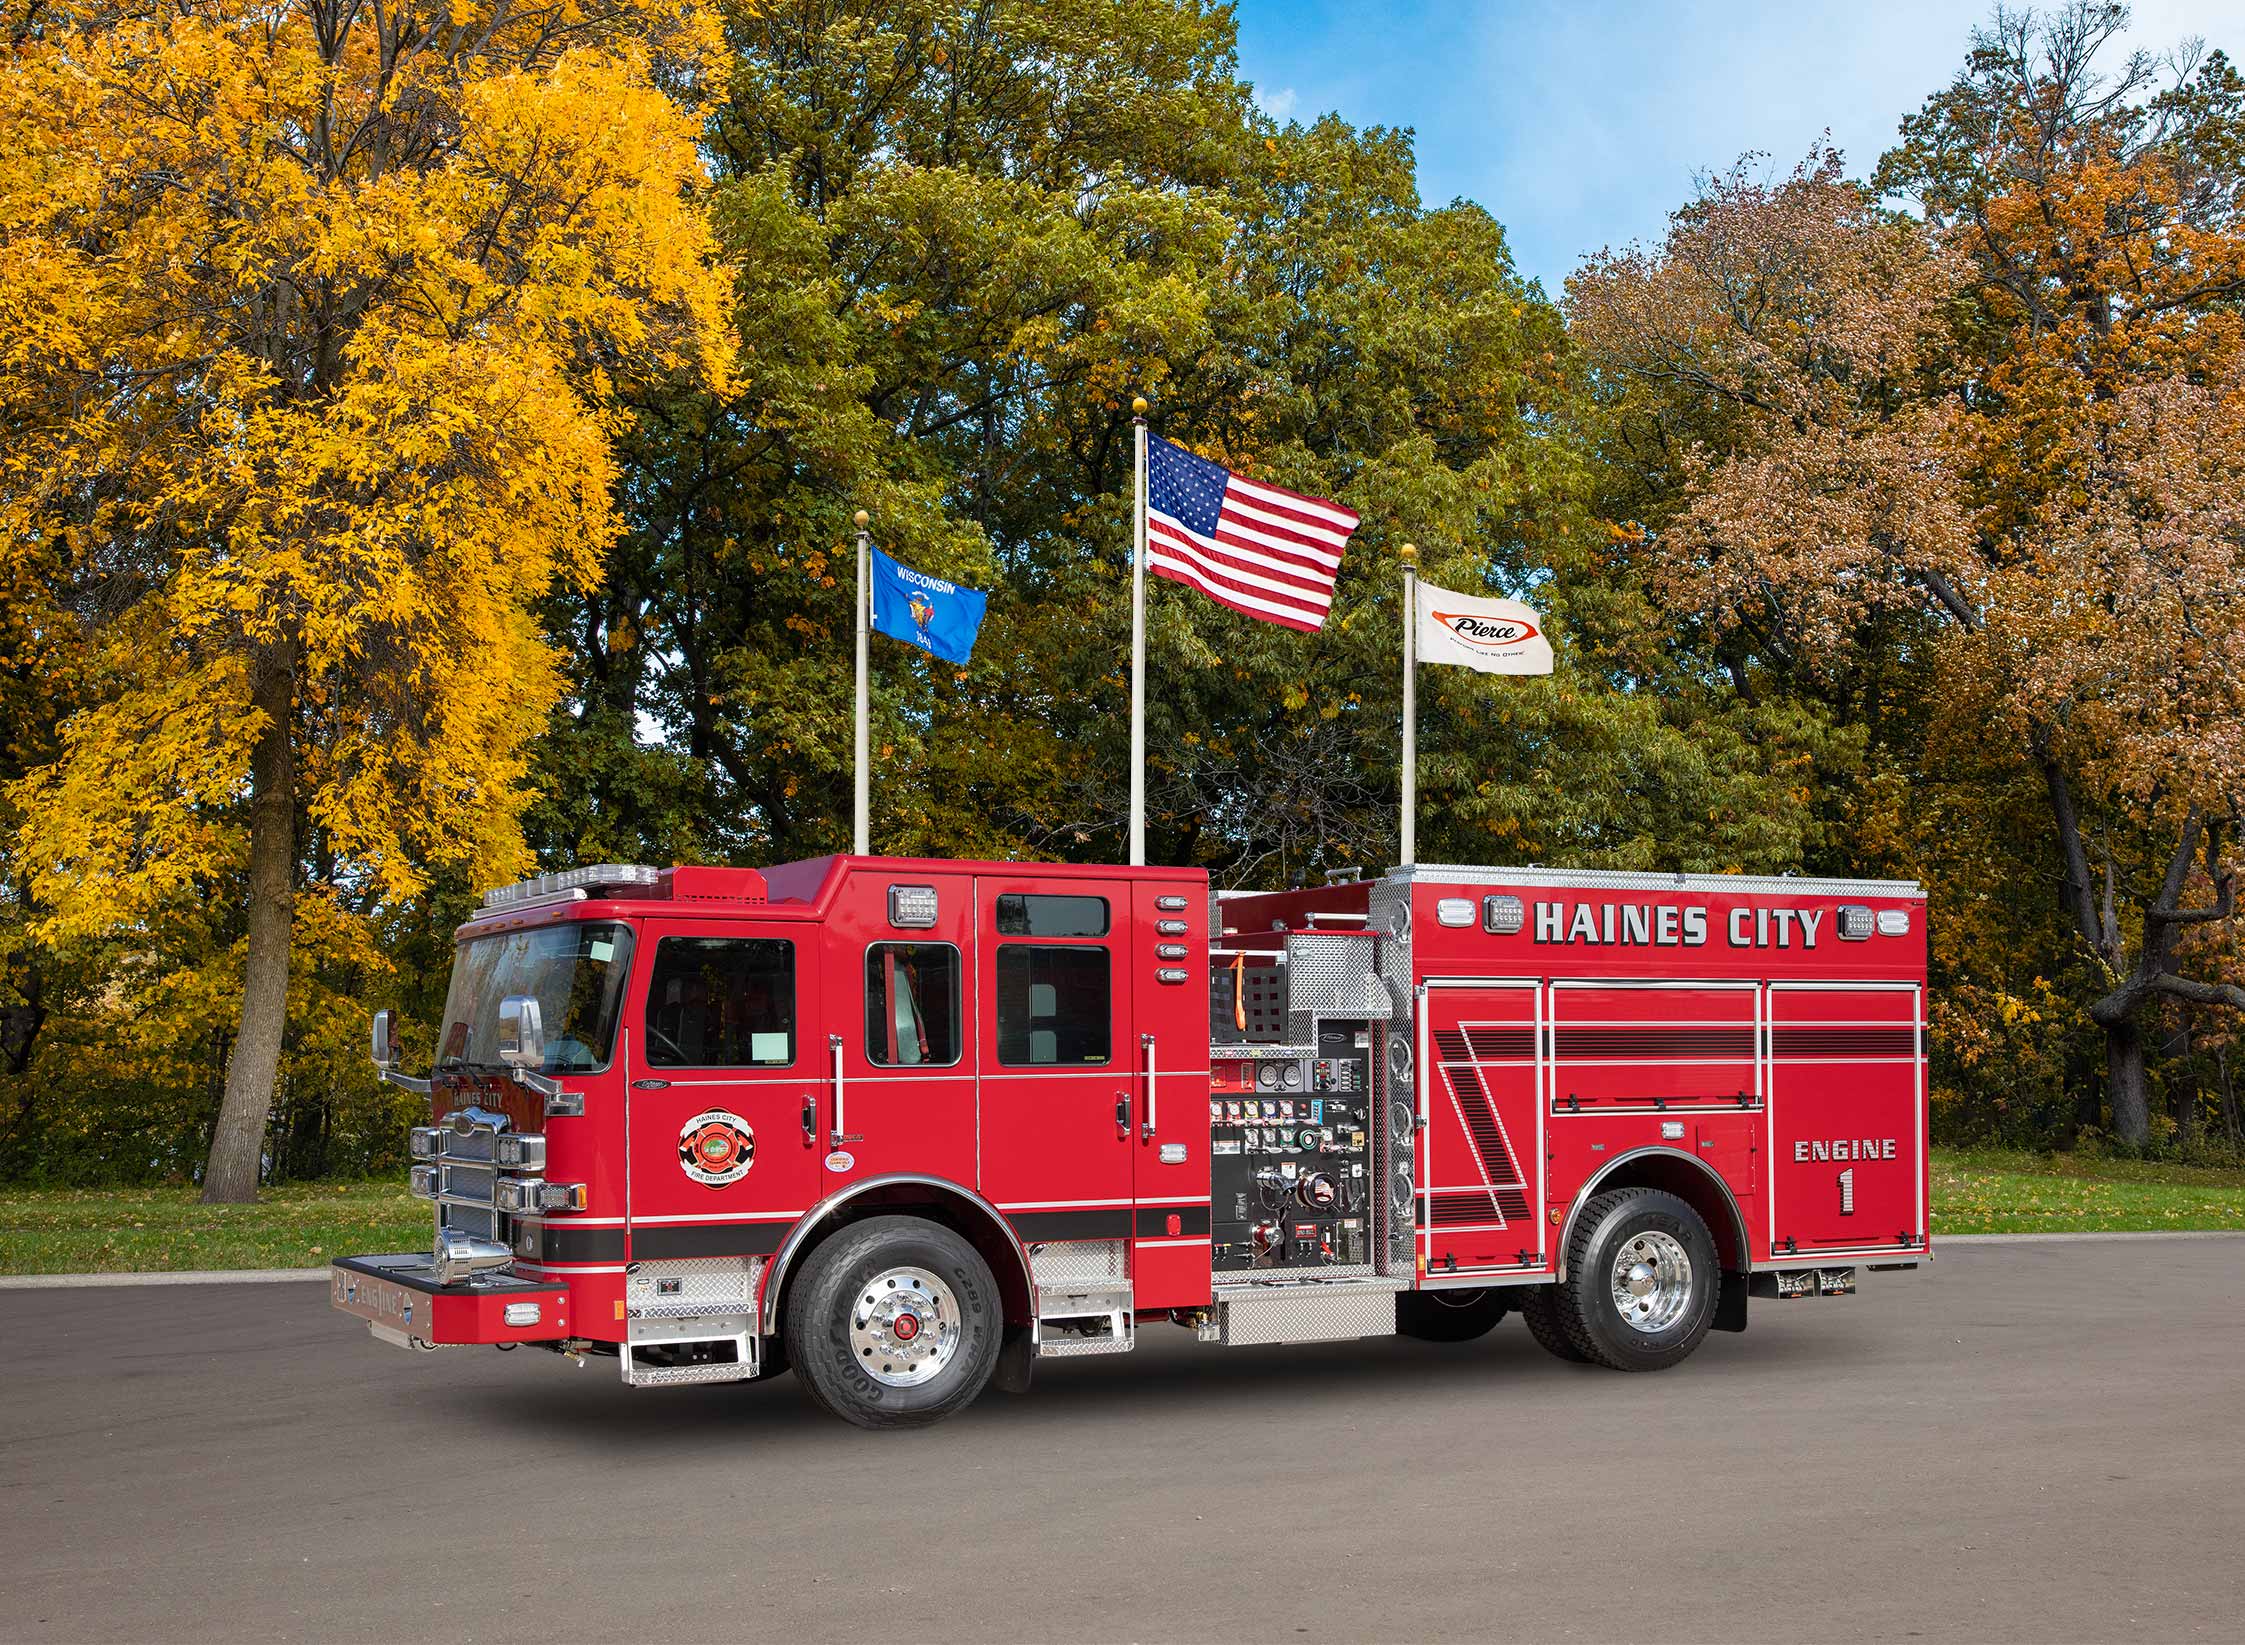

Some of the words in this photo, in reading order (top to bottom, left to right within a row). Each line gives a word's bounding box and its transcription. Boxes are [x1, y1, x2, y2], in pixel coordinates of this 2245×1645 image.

[897, 566, 956, 595] WISCONSIN
[1455, 618, 1515, 639] Pierce
[1533, 902, 1708, 945] HAINES
[1727, 907, 1824, 950] CITY
[453, 1091, 481, 1107] HAINES
[483, 1091, 503, 1109] CITY
[695, 1113, 721, 1124] HAINES
[721, 1114, 737, 1122] CITY
[1794, 1138, 1897, 1163] ENGINE
[690, 1170, 705, 1181] FIRE
[704, 1169, 744, 1182] DEPARTMENT
[1837, 1167, 1855, 1217] 1
